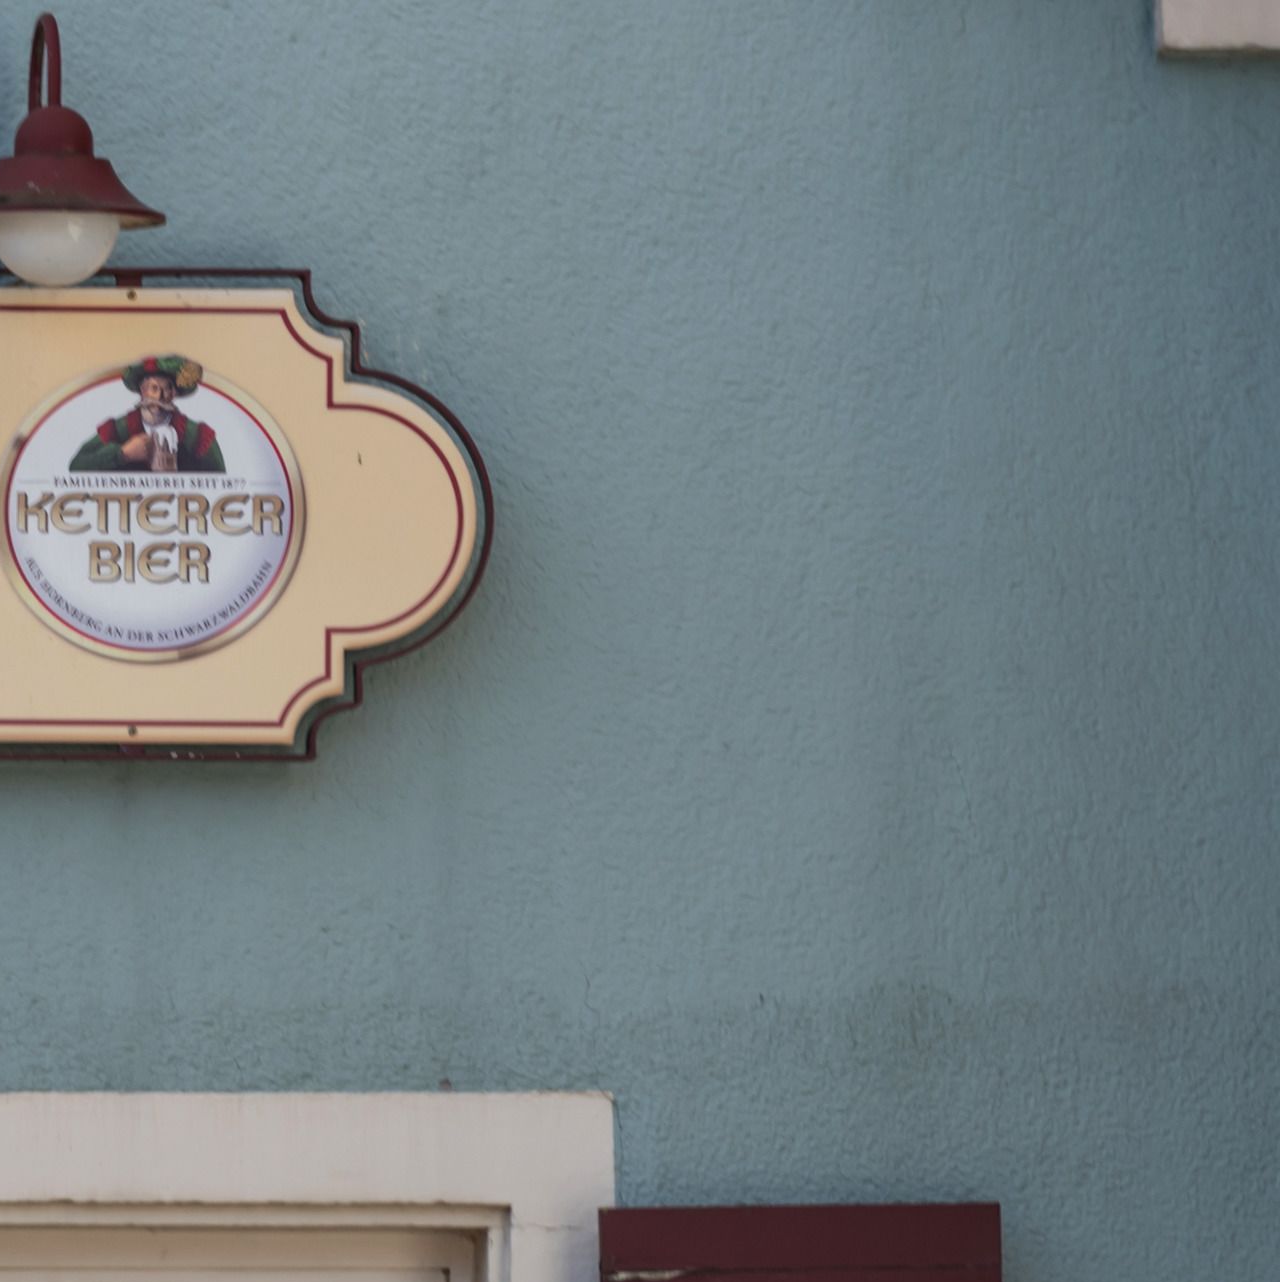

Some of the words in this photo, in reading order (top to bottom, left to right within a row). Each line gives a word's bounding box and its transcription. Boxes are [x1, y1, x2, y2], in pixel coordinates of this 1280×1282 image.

[52, 475, 186, 489] FAMILIENBRAUEREI
[190, 476, 221, 490] SEIT
[15, 491, 285, 536] KETTERER
[88, 539, 212, 584] BIER
[127, 628, 154, 642] DER
[157, 559, 273, 642] SCHWARZWALDBAHN
